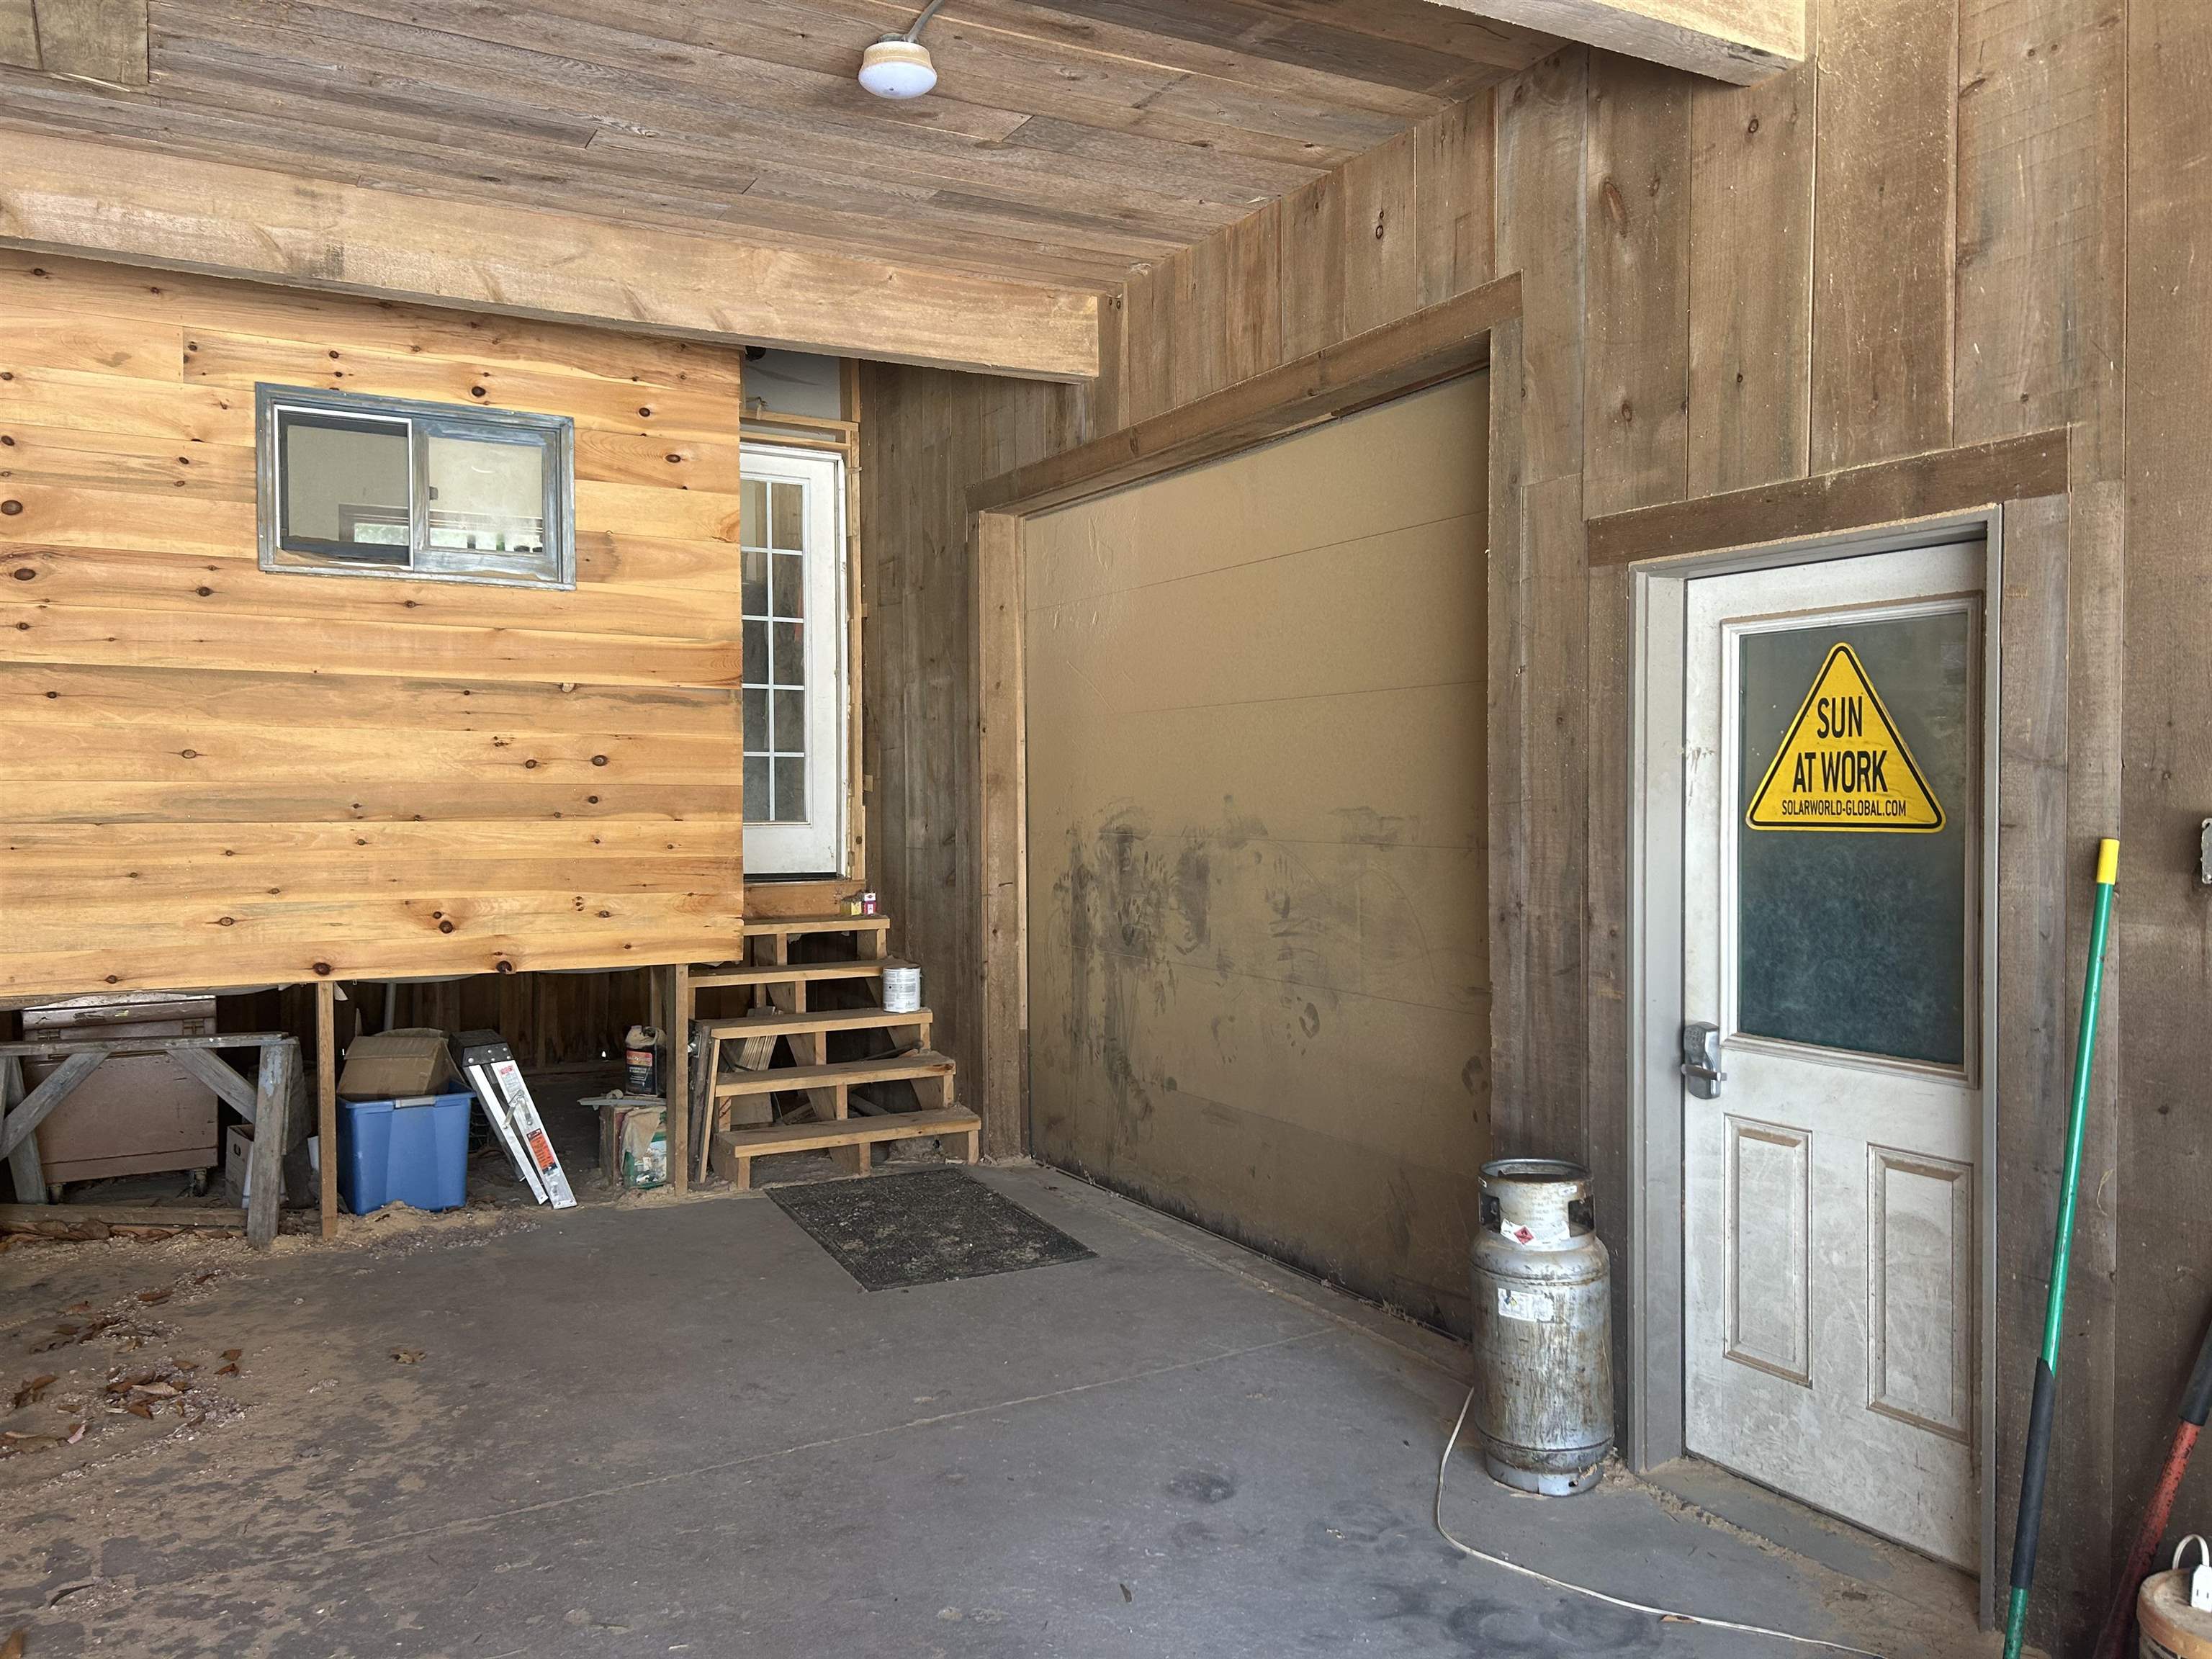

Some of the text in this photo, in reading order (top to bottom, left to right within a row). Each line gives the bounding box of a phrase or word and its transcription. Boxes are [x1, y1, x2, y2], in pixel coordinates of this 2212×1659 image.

[1817, 696, 1862, 739] SUN
[1792, 750, 1888, 793] AT WORK
[1782, 799, 1906, 817] SOLARWORLD-GLOBAL.COM
